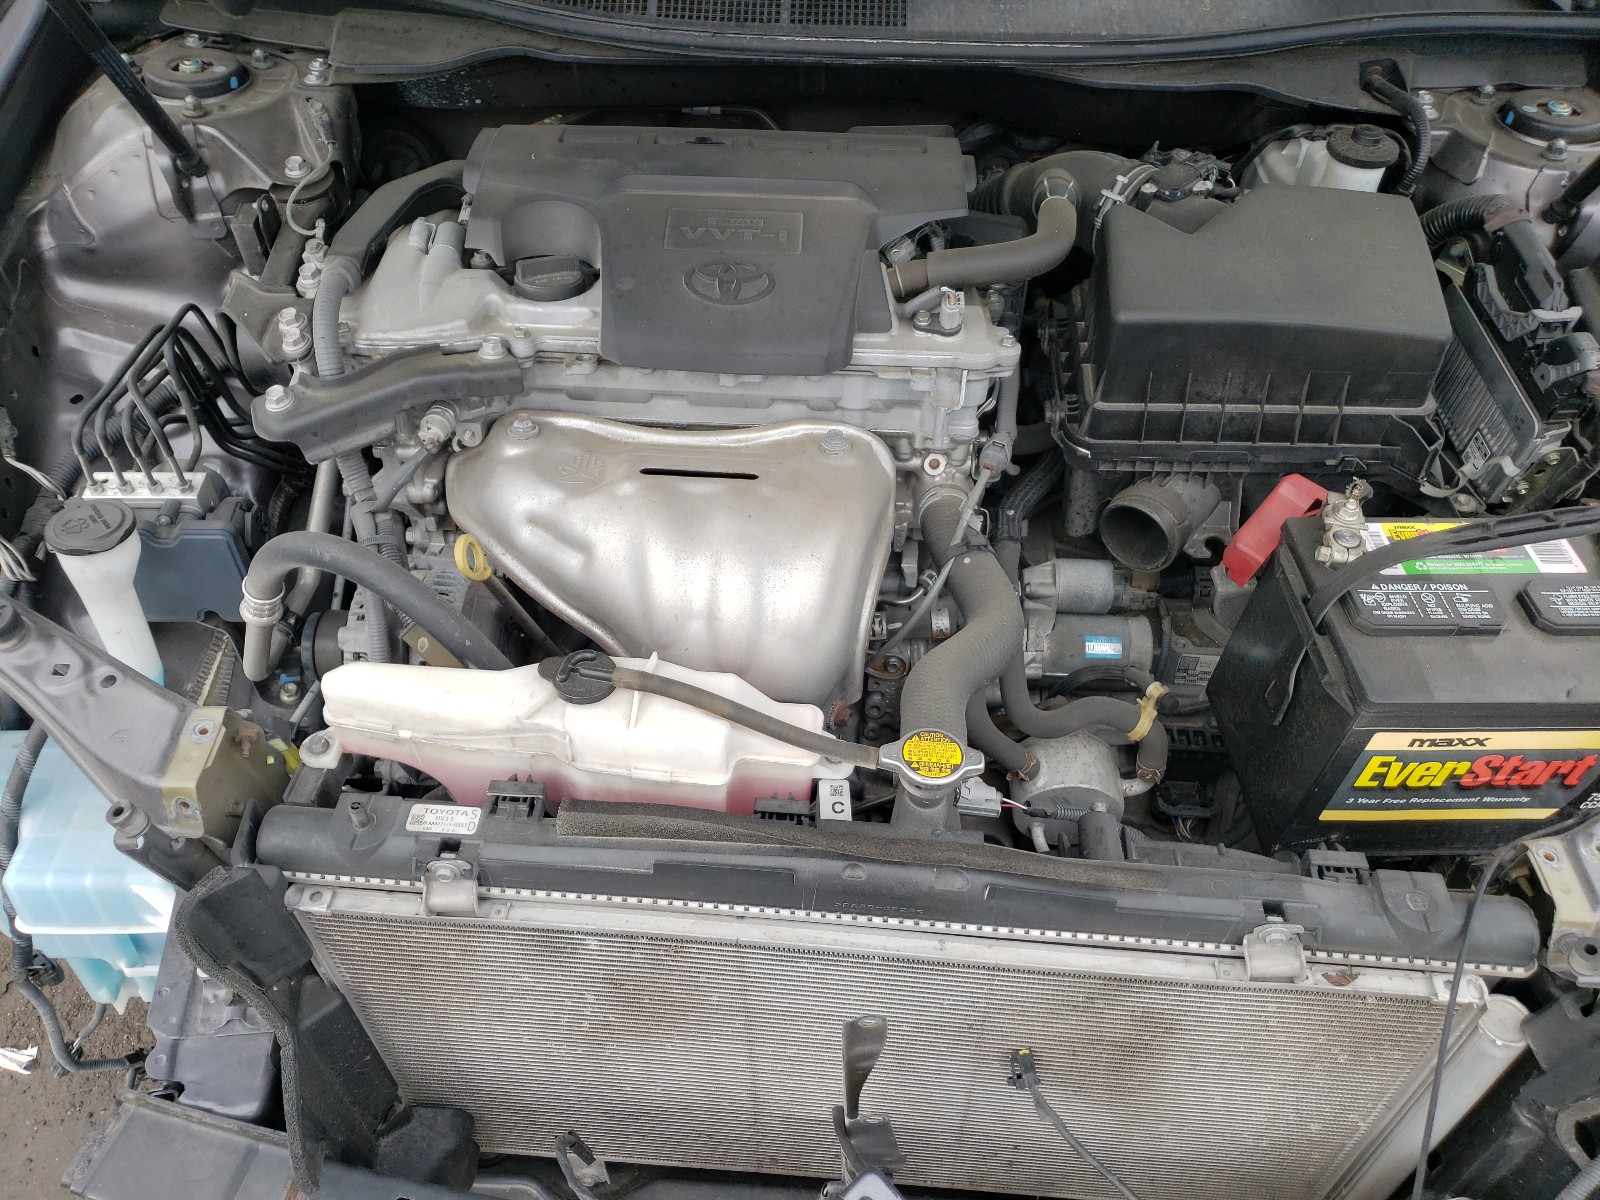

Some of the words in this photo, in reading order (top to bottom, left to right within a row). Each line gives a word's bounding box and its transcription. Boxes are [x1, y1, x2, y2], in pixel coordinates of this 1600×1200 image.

[1407, 737, 1493, 748] maxx
[1353, 754, 1599, 789] EverStart
[1357, 797, 1381, 805] Year
[1408, 796, 1481, 804] Replacement
[1482, 796, 1532, 804] Warranty
[424, 807, 468, 817] TOYOTA
[831, 801, 845, 814] C
[470, 809, 479, 820] S
[467, 821, 476, 832] D
